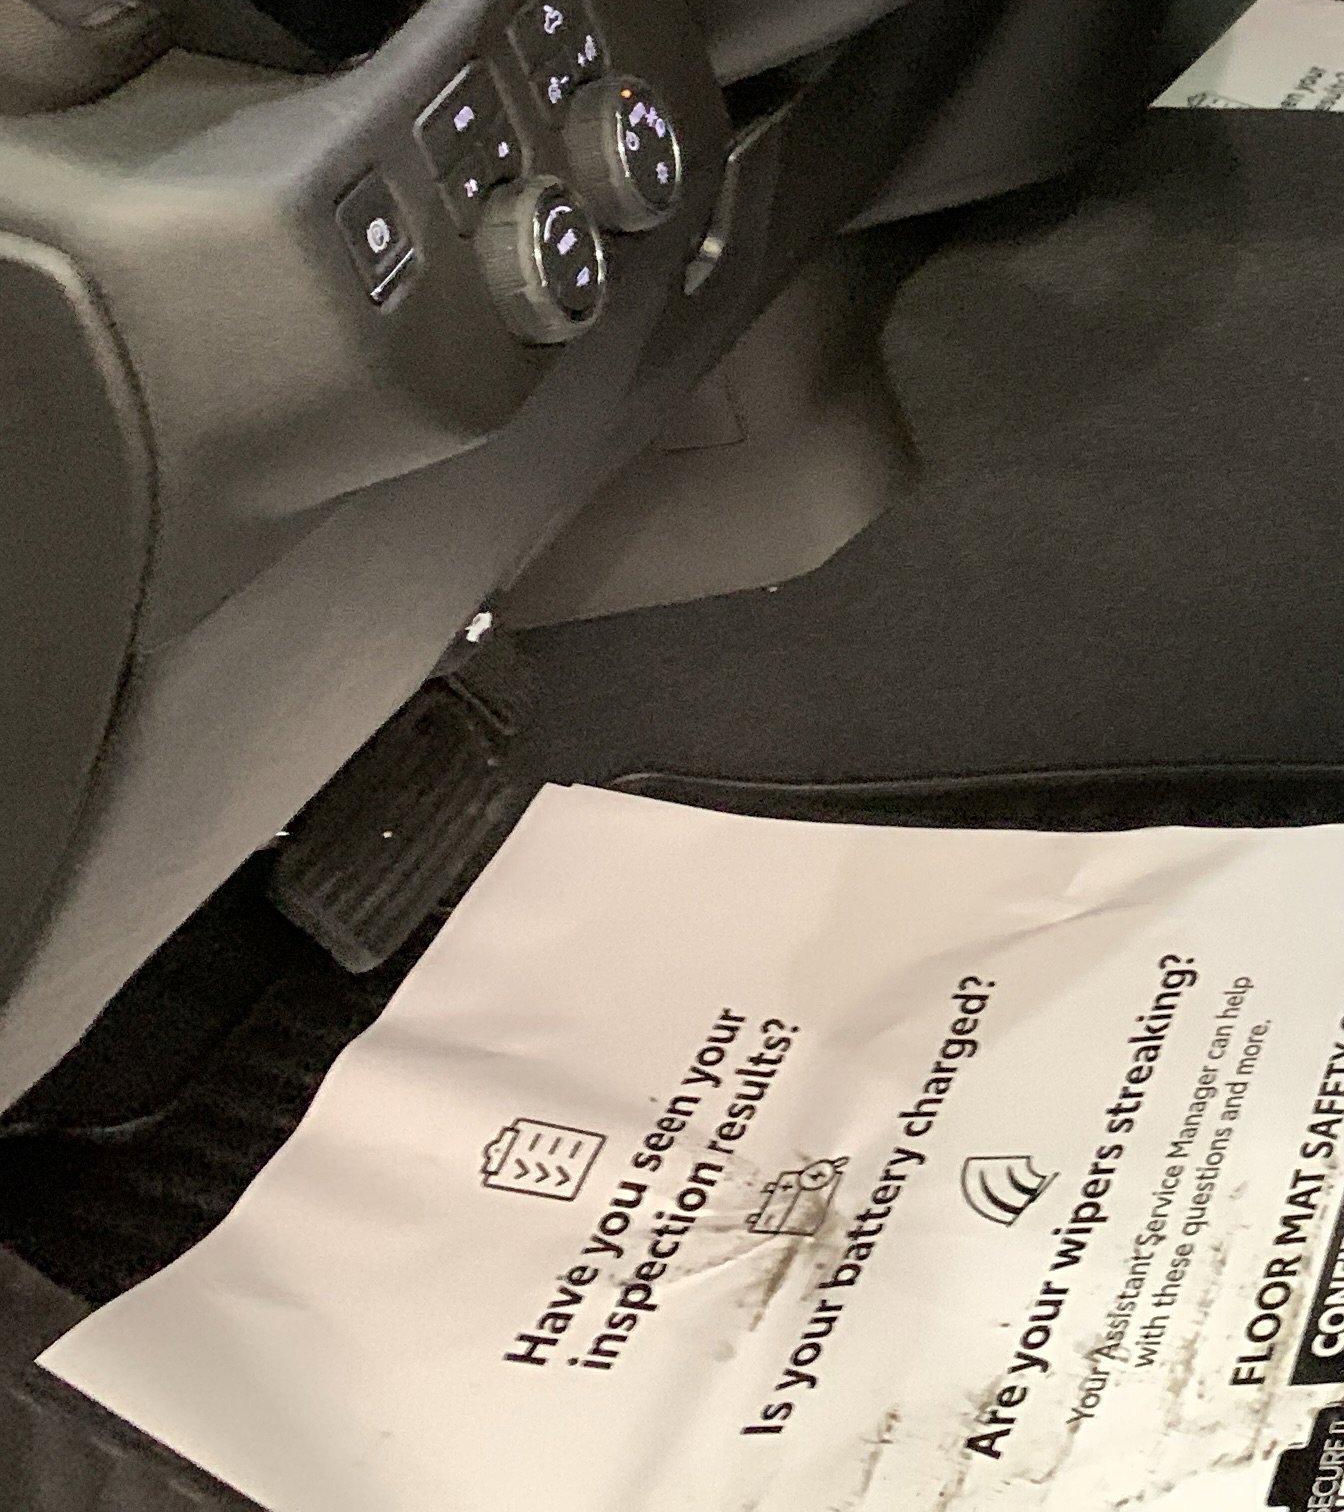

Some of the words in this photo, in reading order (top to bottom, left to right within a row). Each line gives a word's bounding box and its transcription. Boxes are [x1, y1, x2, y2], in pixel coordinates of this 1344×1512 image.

[1216, 976, 1254, 1019] help
[1208, 1024, 1234, 1060] can
[1236, 1019, 1272, 1075] more.
[1165, 1066, 1219, 1158] Manager
[1221, 1081, 1248, 1121] and
[505, 1262, 599, 1366] Have
[582, 1183, 648, 1259] you
[634, 1093, 701, 1174] seen
[681, 1007, 747, 1093] your
[568, 1158, 724, 1370] inspection
[708, 1018, 800, 1157] results?
[742, 1400, 793, 1436] Is
[778, 1299, 839, 1391] your
[818, 1146, 926, 1290] battery
[899, 975, 996, 1137] charged?
[966, 1381, 1029, 1459] Are
[1011, 1278, 1072, 1380] your
[1050, 1142, 1124, 1270] wipers
[1105, 954, 1197, 1135] streaking?
[1135, 1165, 1184, 1246] Service
[1182, 1127, 1232, 1236] questions
[1094, 1250, 1155, 1361] Assistant
[1152, 1243, 1194, 1308] these
[1229, 1254, 1300, 1386] FLOOR
[1274, 1169, 1328, 1245] MAT
[1135, 1316, 1170, 1368] with
[1066, 1367, 1110, 1424] Your
